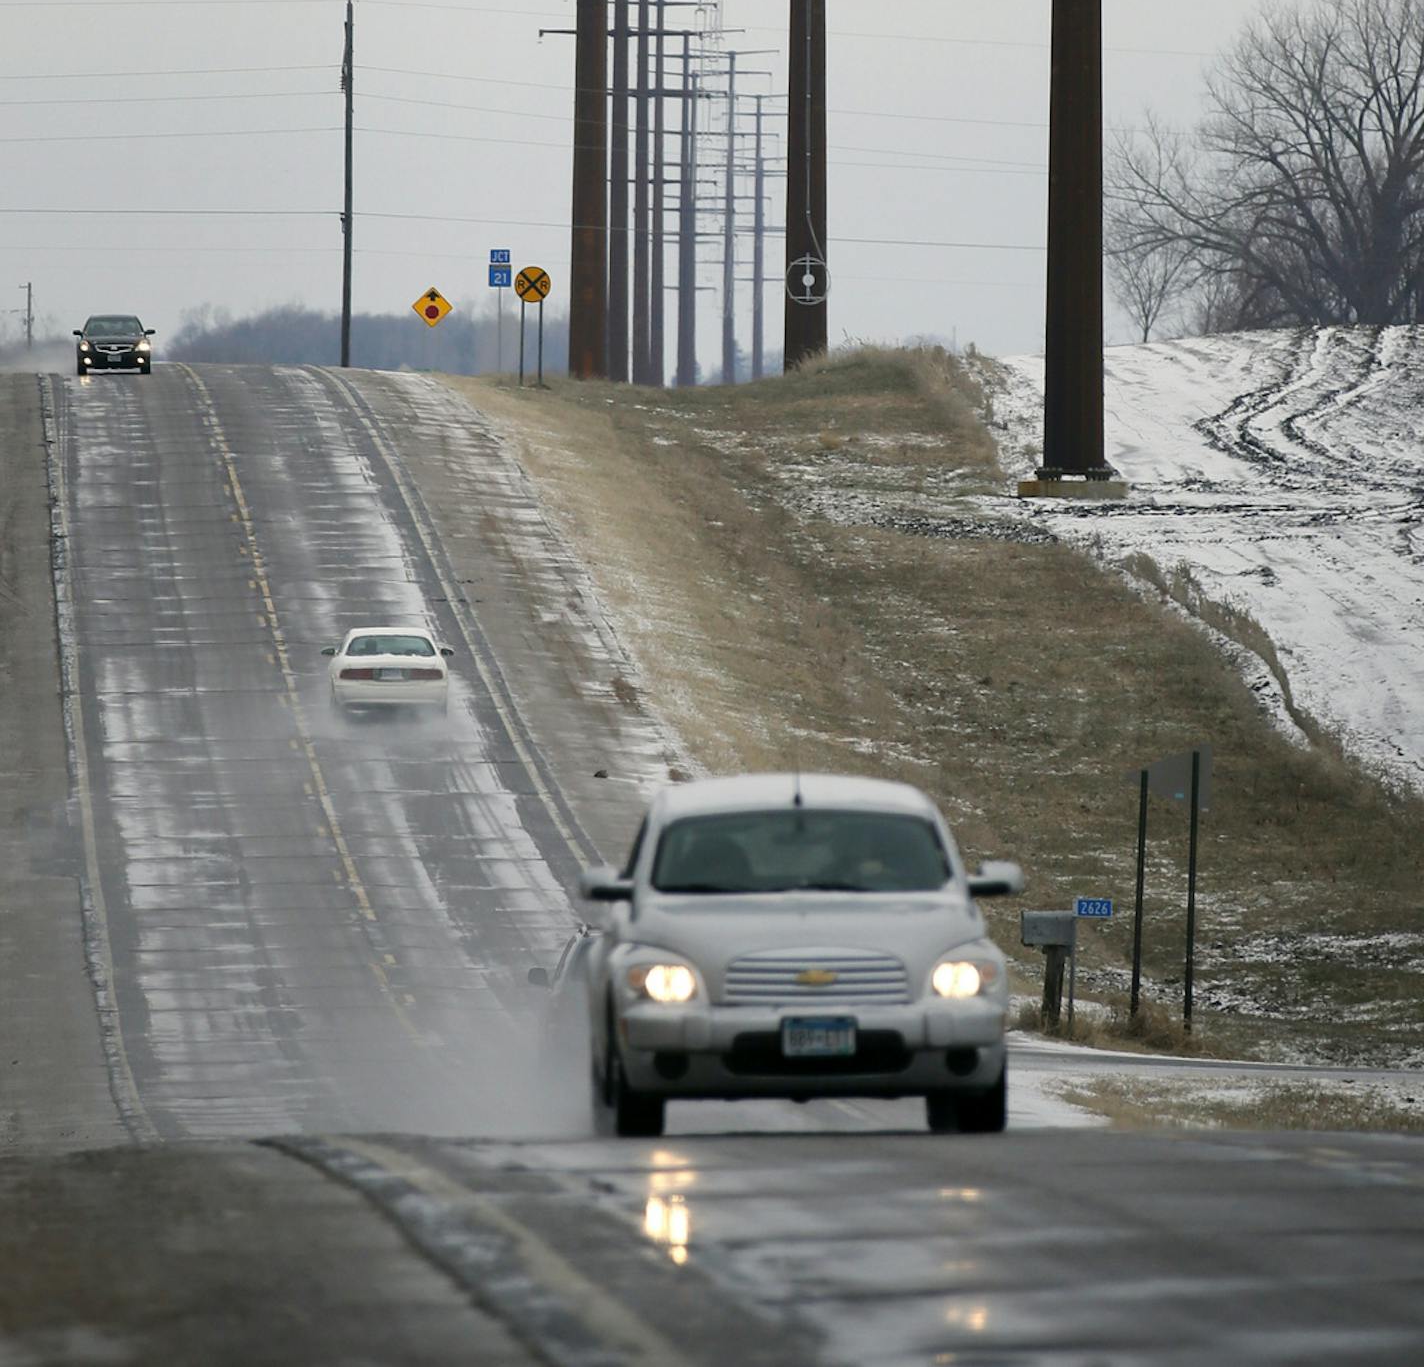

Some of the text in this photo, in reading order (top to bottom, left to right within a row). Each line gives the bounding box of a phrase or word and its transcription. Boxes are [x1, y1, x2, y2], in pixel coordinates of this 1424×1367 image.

[491, 251, 509, 262] JCT
[494, 273, 507, 284] 21
[517, 280, 548, 290] R R
[1080, 902, 1108, 914] 2626
